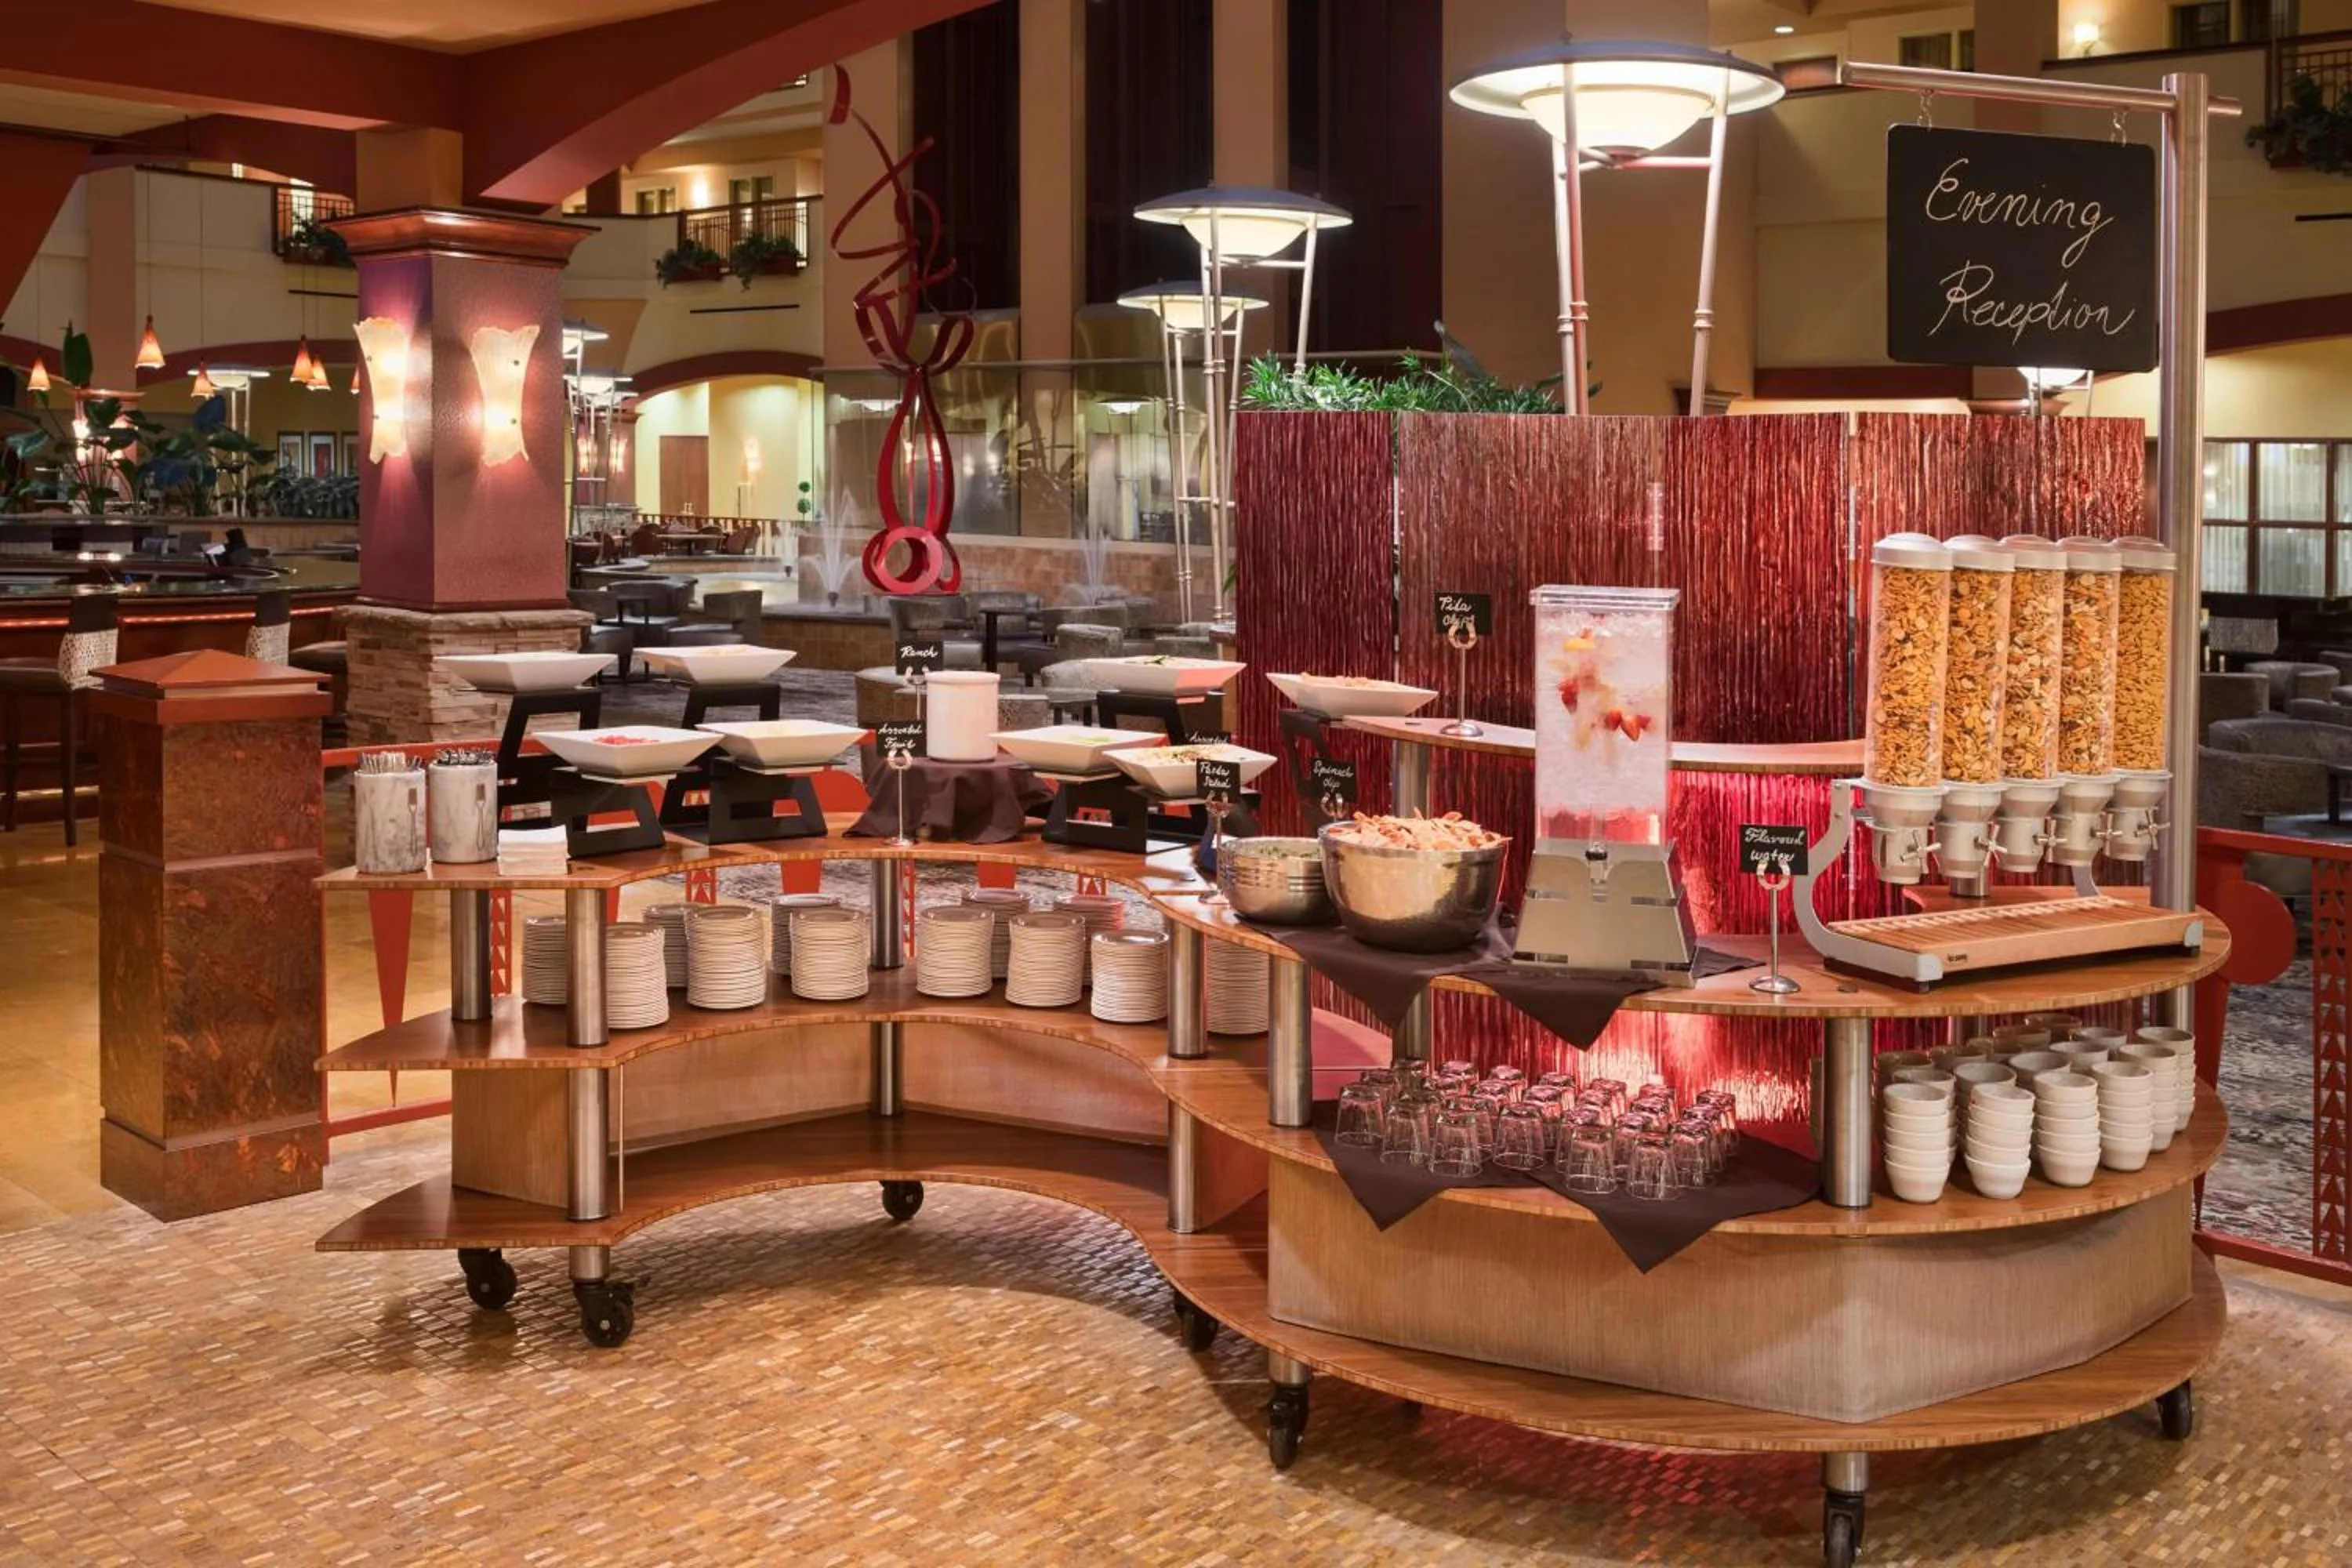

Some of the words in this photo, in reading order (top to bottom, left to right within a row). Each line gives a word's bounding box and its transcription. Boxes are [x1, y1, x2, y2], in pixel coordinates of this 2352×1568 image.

[1926, 158, 2115, 268] Evening
[1927, 260, 2135, 346] Reception
[1439, 596, 1472, 612] Pita
[900, 645, 938, 659] Ranch
[877, 722, 923, 735] Assorted
[884, 736, 916, 750] Fruit
[1200, 761, 1230, 777] Pasta
[1312, 760, 1355, 779] Spinach
